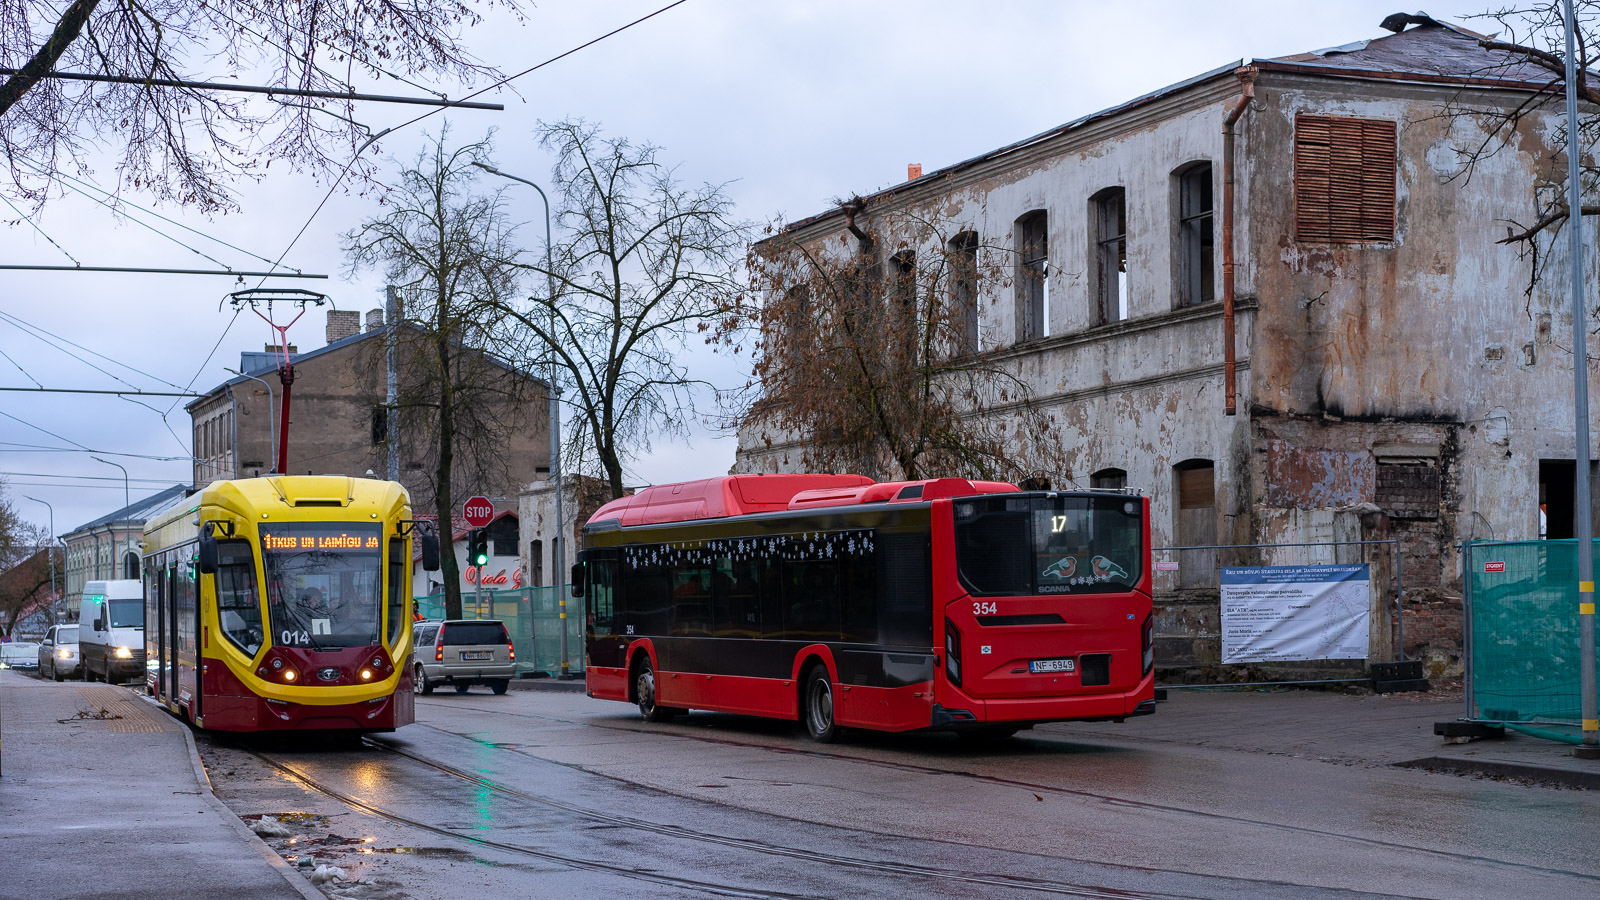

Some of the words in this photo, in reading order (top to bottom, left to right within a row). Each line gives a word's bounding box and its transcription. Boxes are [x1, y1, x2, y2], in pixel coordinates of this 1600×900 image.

[466, 506, 491, 518] STOP
[1051, 515, 1067, 533] 17
[301, 536, 315, 548] UN
[318, 533, 362, 548] LAIMĪGU
[365, 536, 379, 548] JA
[1038, 585, 1071, 593] SCANIA
[972, 601, 998, 615] 354
[281, 630, 311, 645] 014
[1035, 660, 1073, 670] NF-6949
